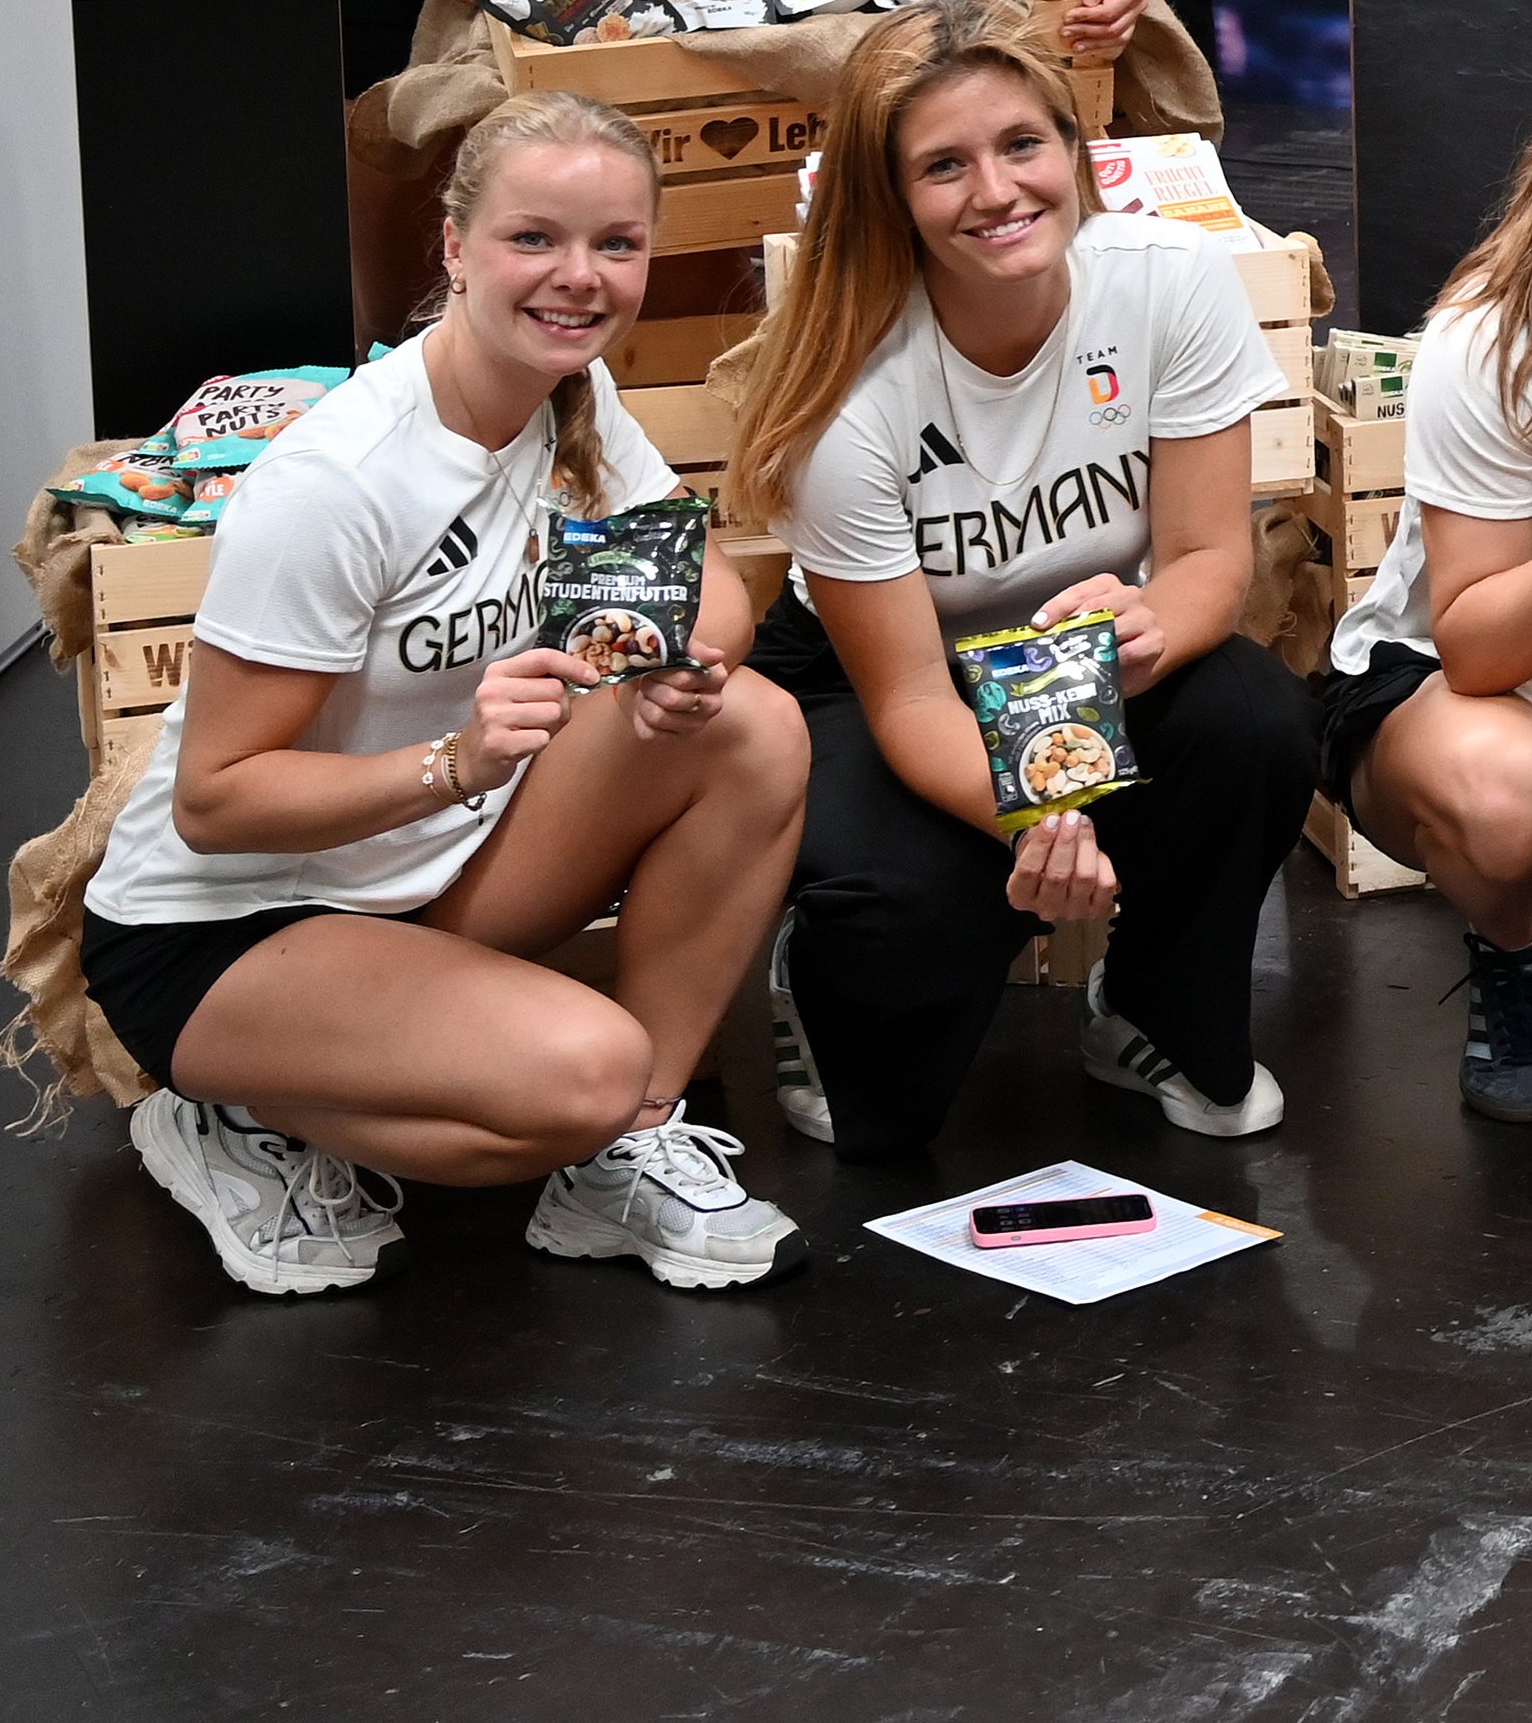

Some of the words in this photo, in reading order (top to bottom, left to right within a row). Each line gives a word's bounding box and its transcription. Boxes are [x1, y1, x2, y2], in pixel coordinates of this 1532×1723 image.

[1077, 346, 1119, 365] TEAM
[199, 384, 285, 402] PARTY
[198, 402, 286, 427] PARTY
[1376, 403, 1406, 419] NUS
[206, 410, 280, 438] NUTS
[563, 532, 607, 544] EDEKA
[544, 582, 688, 602] STUDENTENFUTTER
[1038, 703, 1072, 725] MIX
